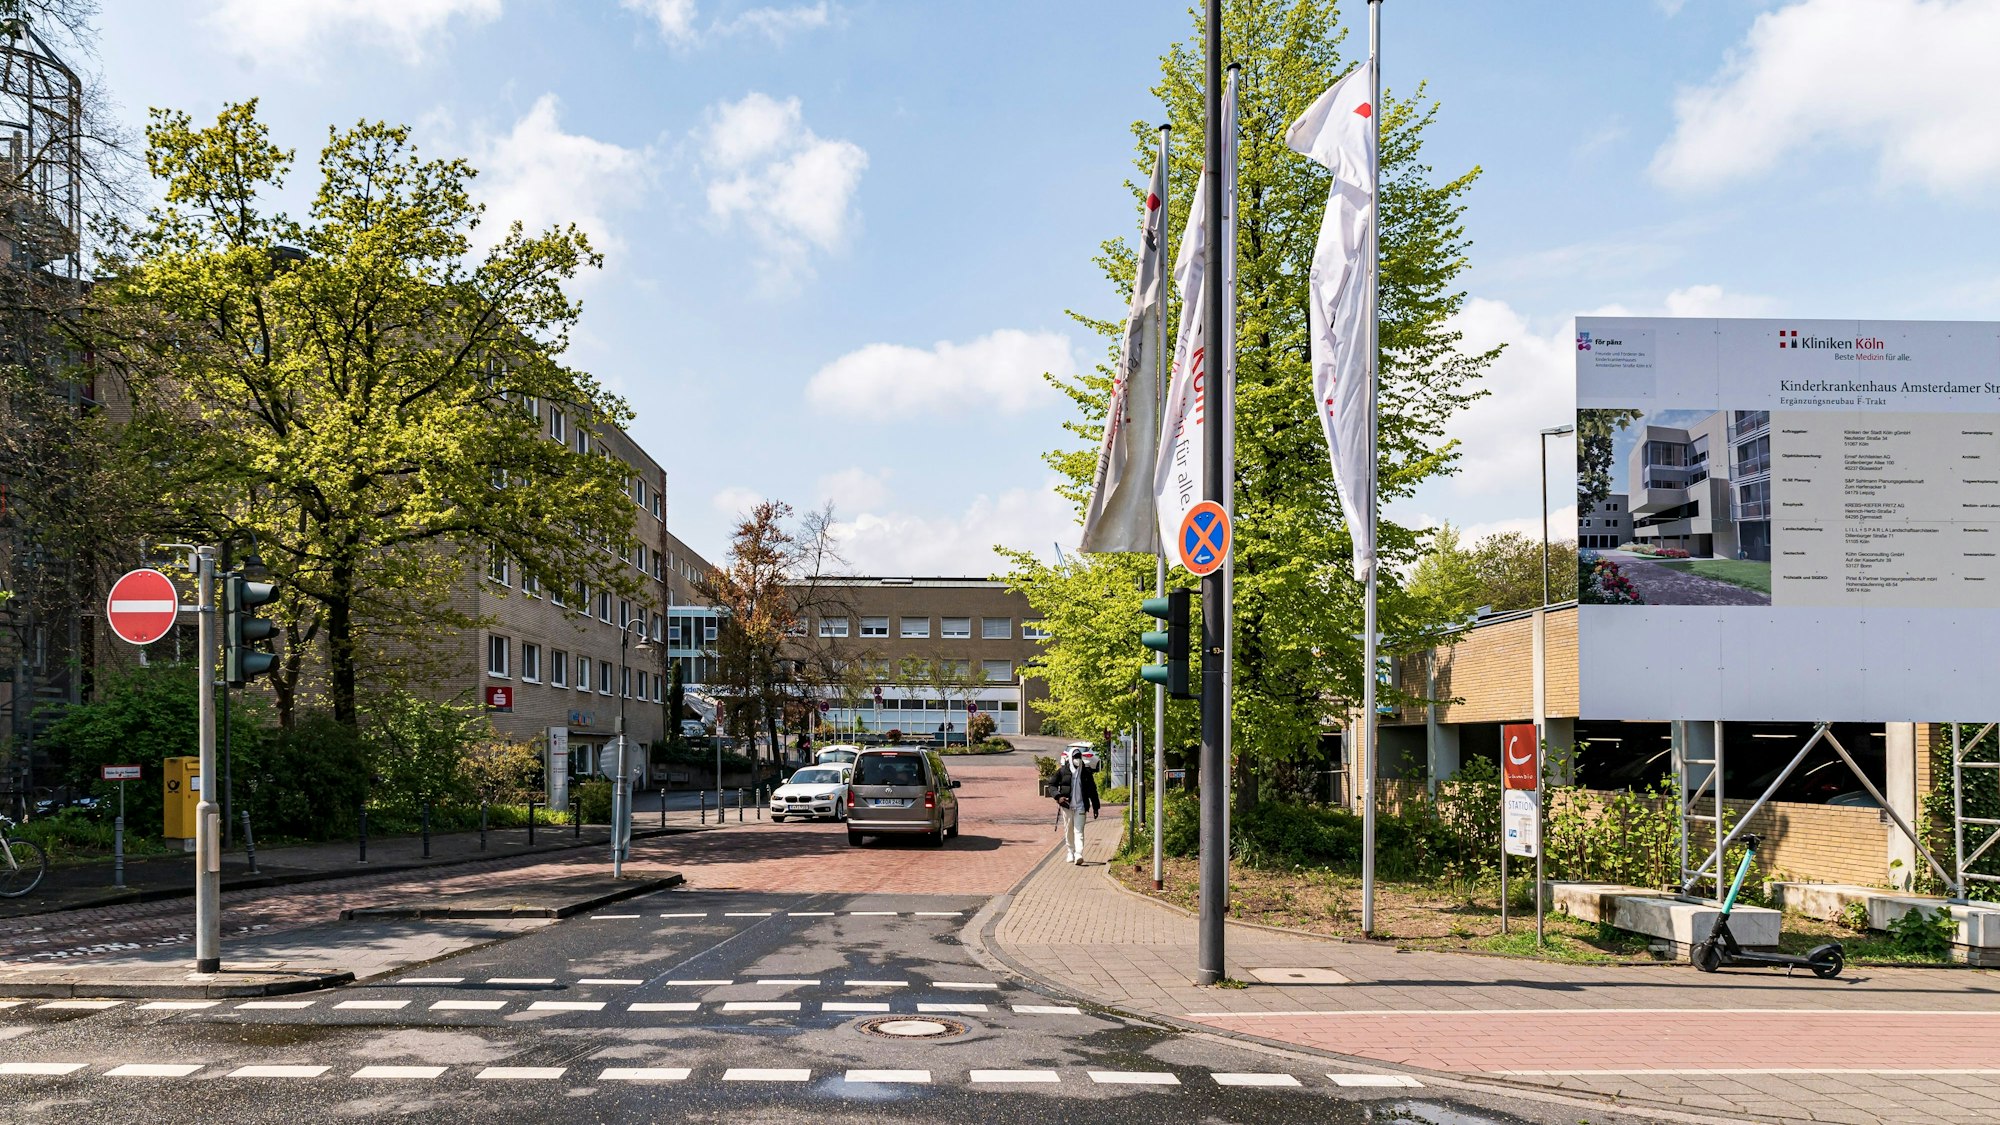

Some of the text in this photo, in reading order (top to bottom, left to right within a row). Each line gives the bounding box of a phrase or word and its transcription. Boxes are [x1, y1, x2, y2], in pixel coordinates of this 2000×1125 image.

[1802, 337, 1884, 349] Kliniken Köln
[1781, 380, 1897, 392] Kinderkrankenhaus
[1901, 382, 1981, 393] Amsterdamer
[1780, 397, 1854, 406] Ergänzungsneubau
[1508, 800, 1533, 810] STATION
